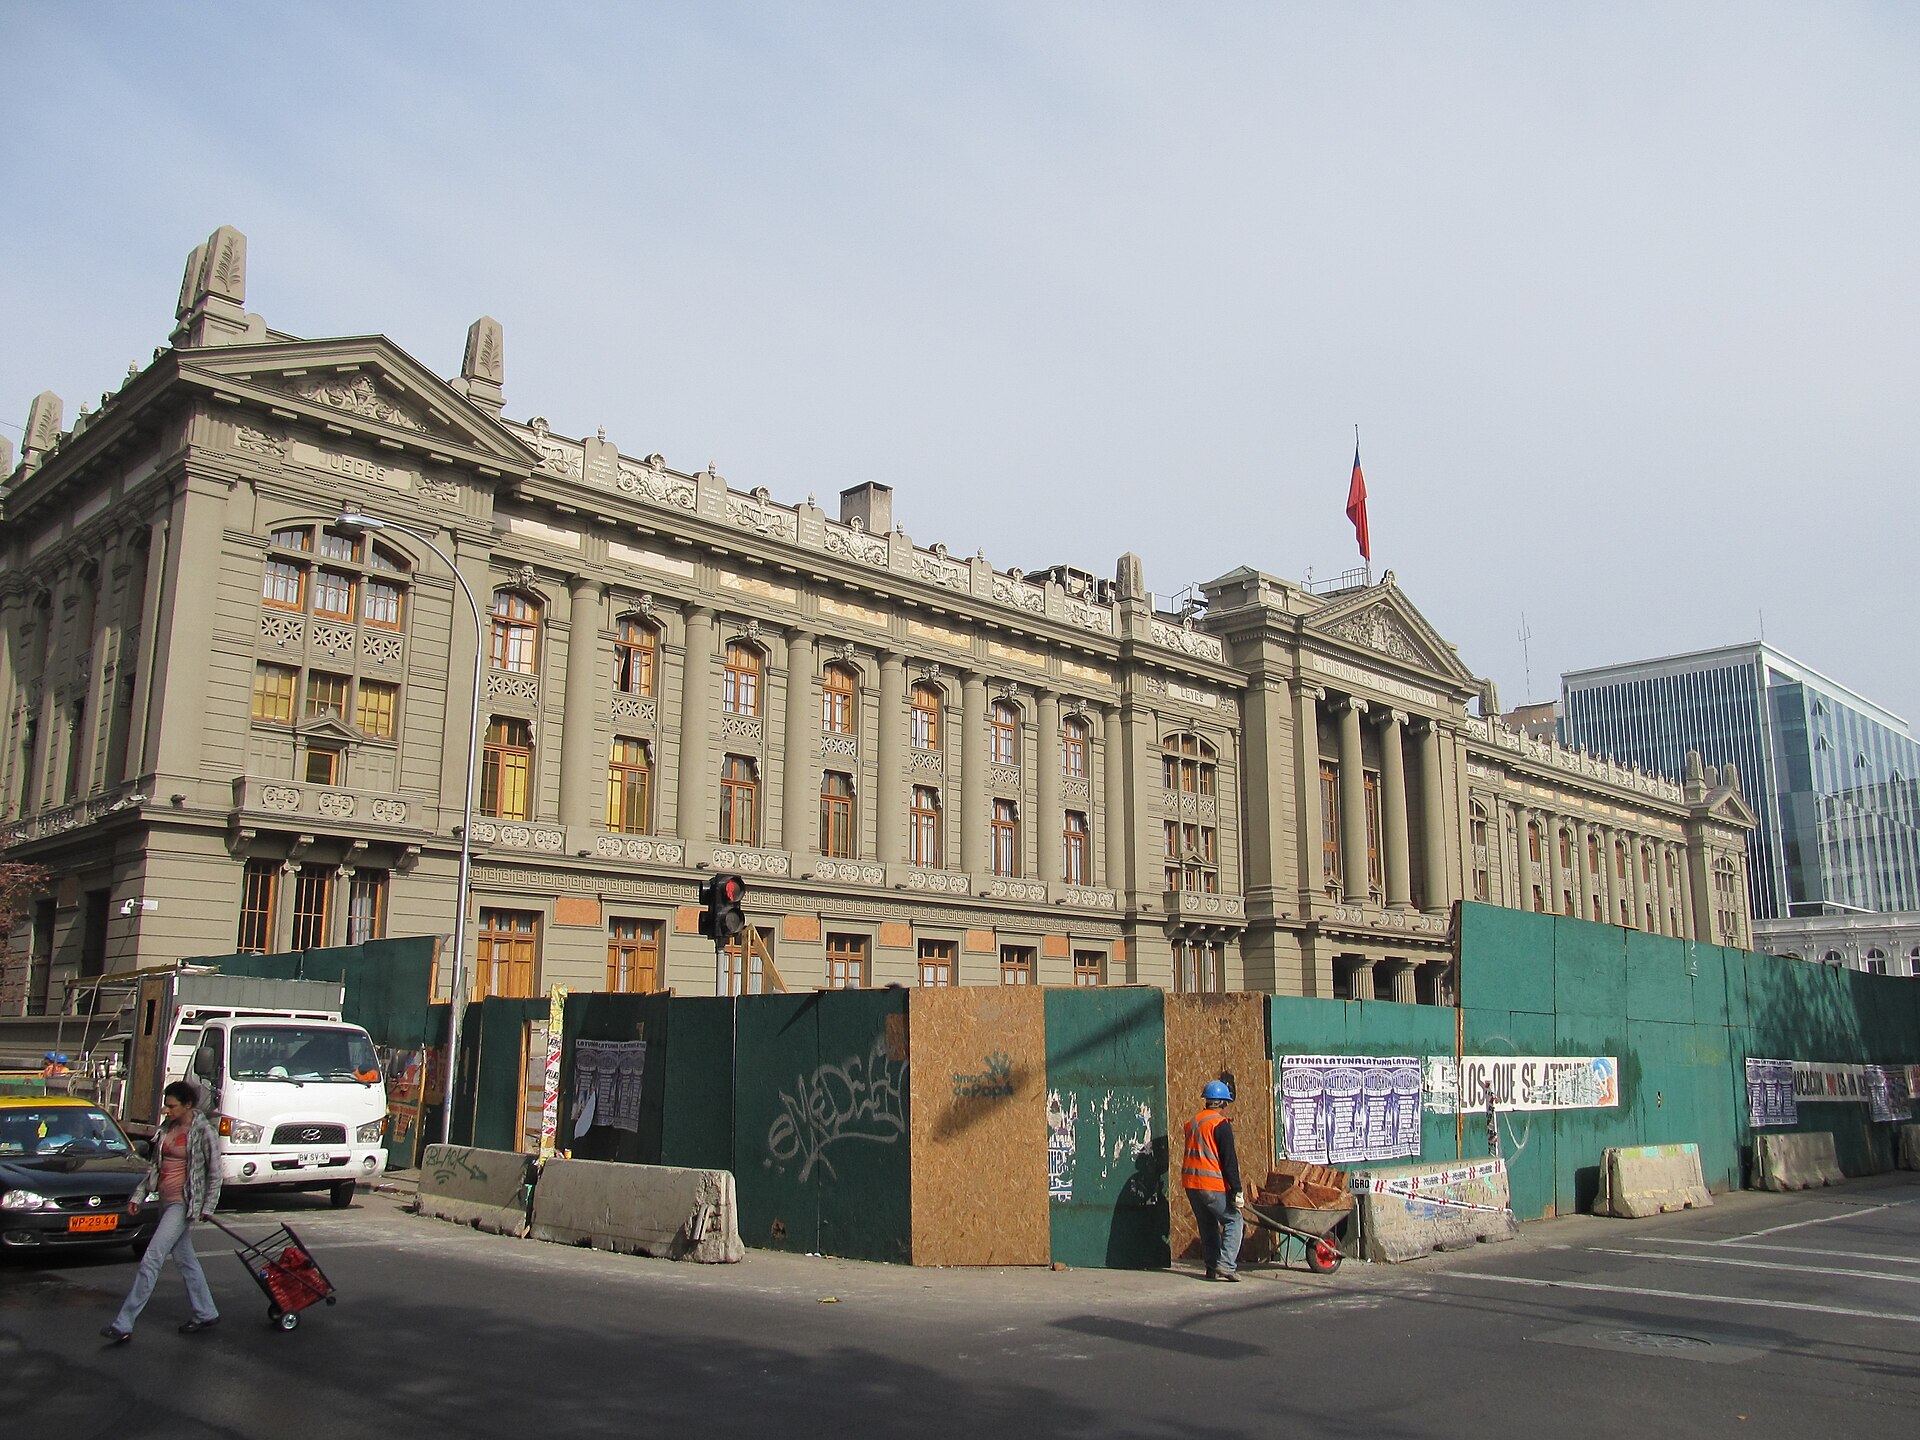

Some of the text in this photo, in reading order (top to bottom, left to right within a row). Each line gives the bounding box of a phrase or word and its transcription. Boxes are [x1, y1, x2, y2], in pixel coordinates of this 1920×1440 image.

[1180, 687, 1204, 703] LEYES
[1320, 658, 1431, 706] TRIBUNALES DE JUSTICIA
[1460, 1062, 1486, 1108] LOS
[1493, 1062, 1516, 1105] QUE
